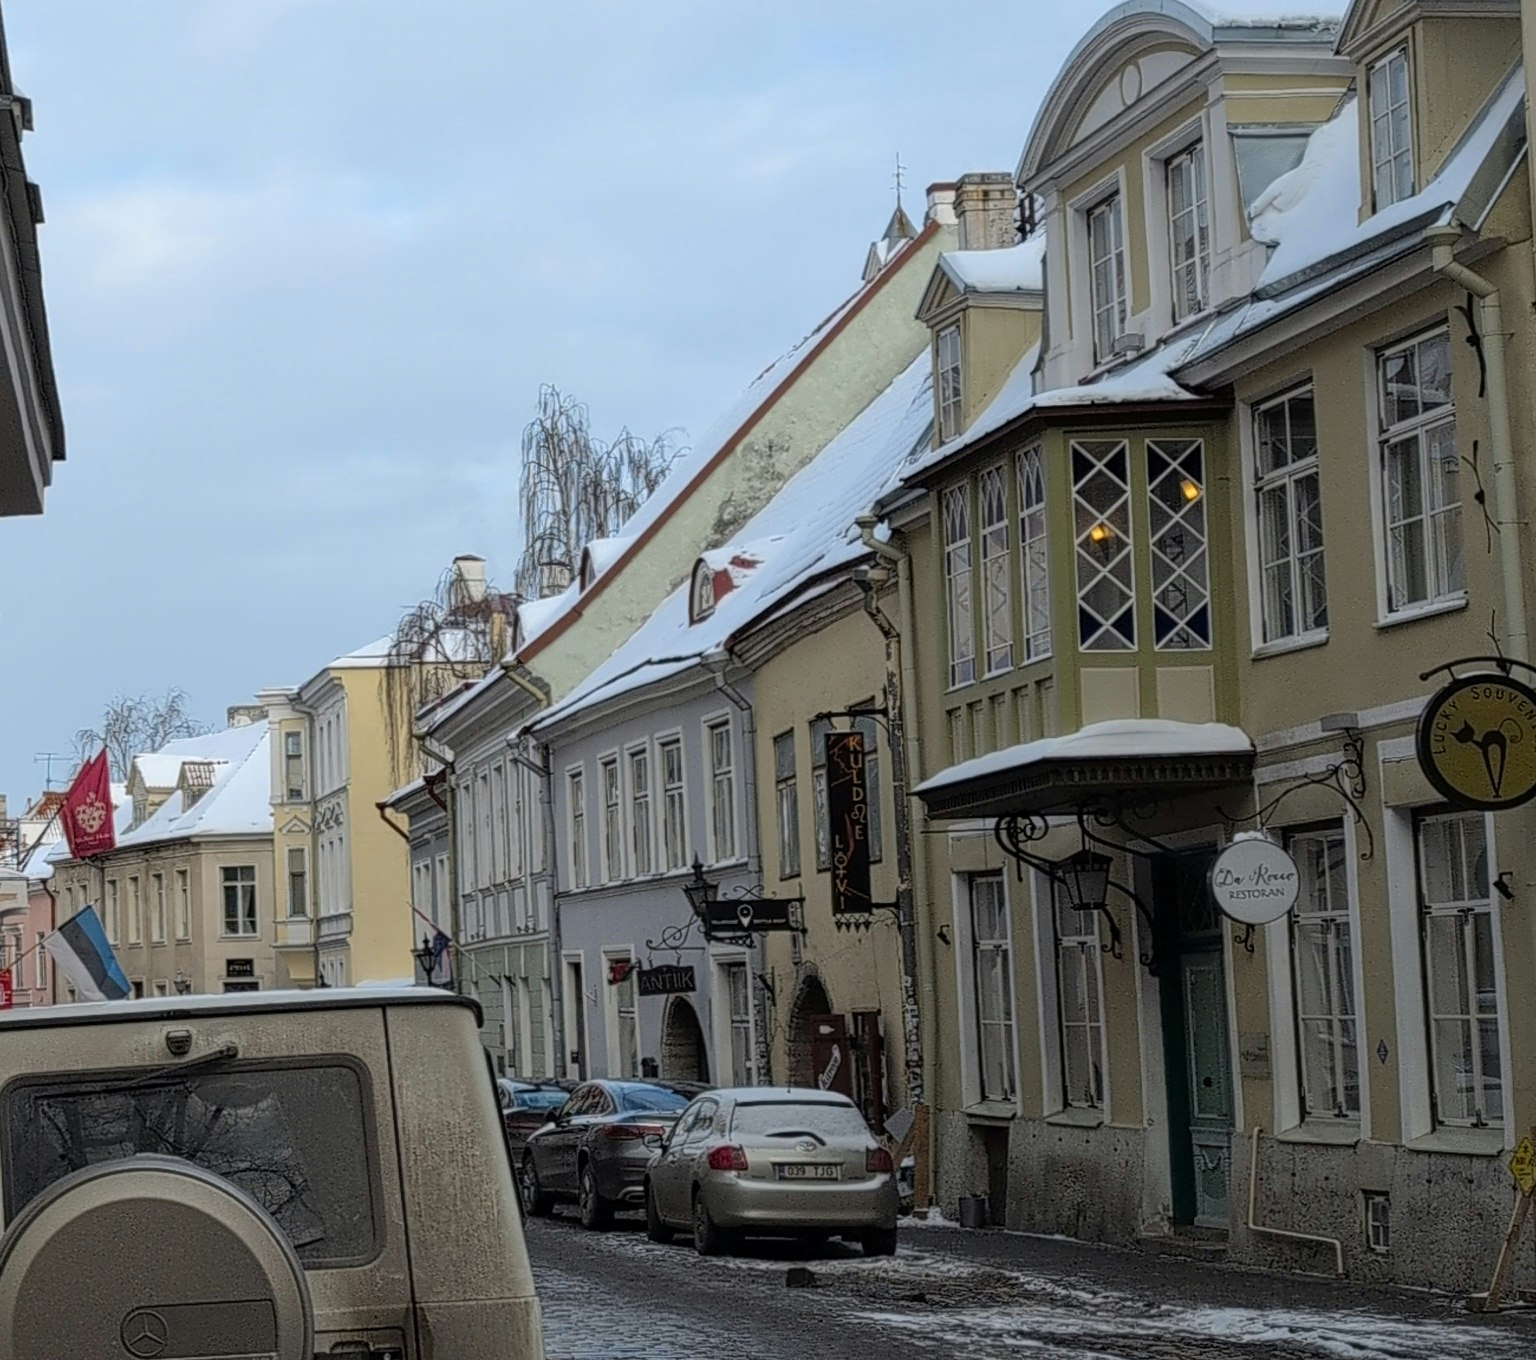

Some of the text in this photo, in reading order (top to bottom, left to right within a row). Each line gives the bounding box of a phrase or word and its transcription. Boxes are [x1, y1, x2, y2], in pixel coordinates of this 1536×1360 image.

[1433, 700, 1459, 754] LUCKY
[1214, 868, 1244, 887] Da
[1229, 887, 1285, 900] RESTORAN
[641, 971, 693, 990] ANTIIK
[787, 1166, 834, 1176] 039 TJG
